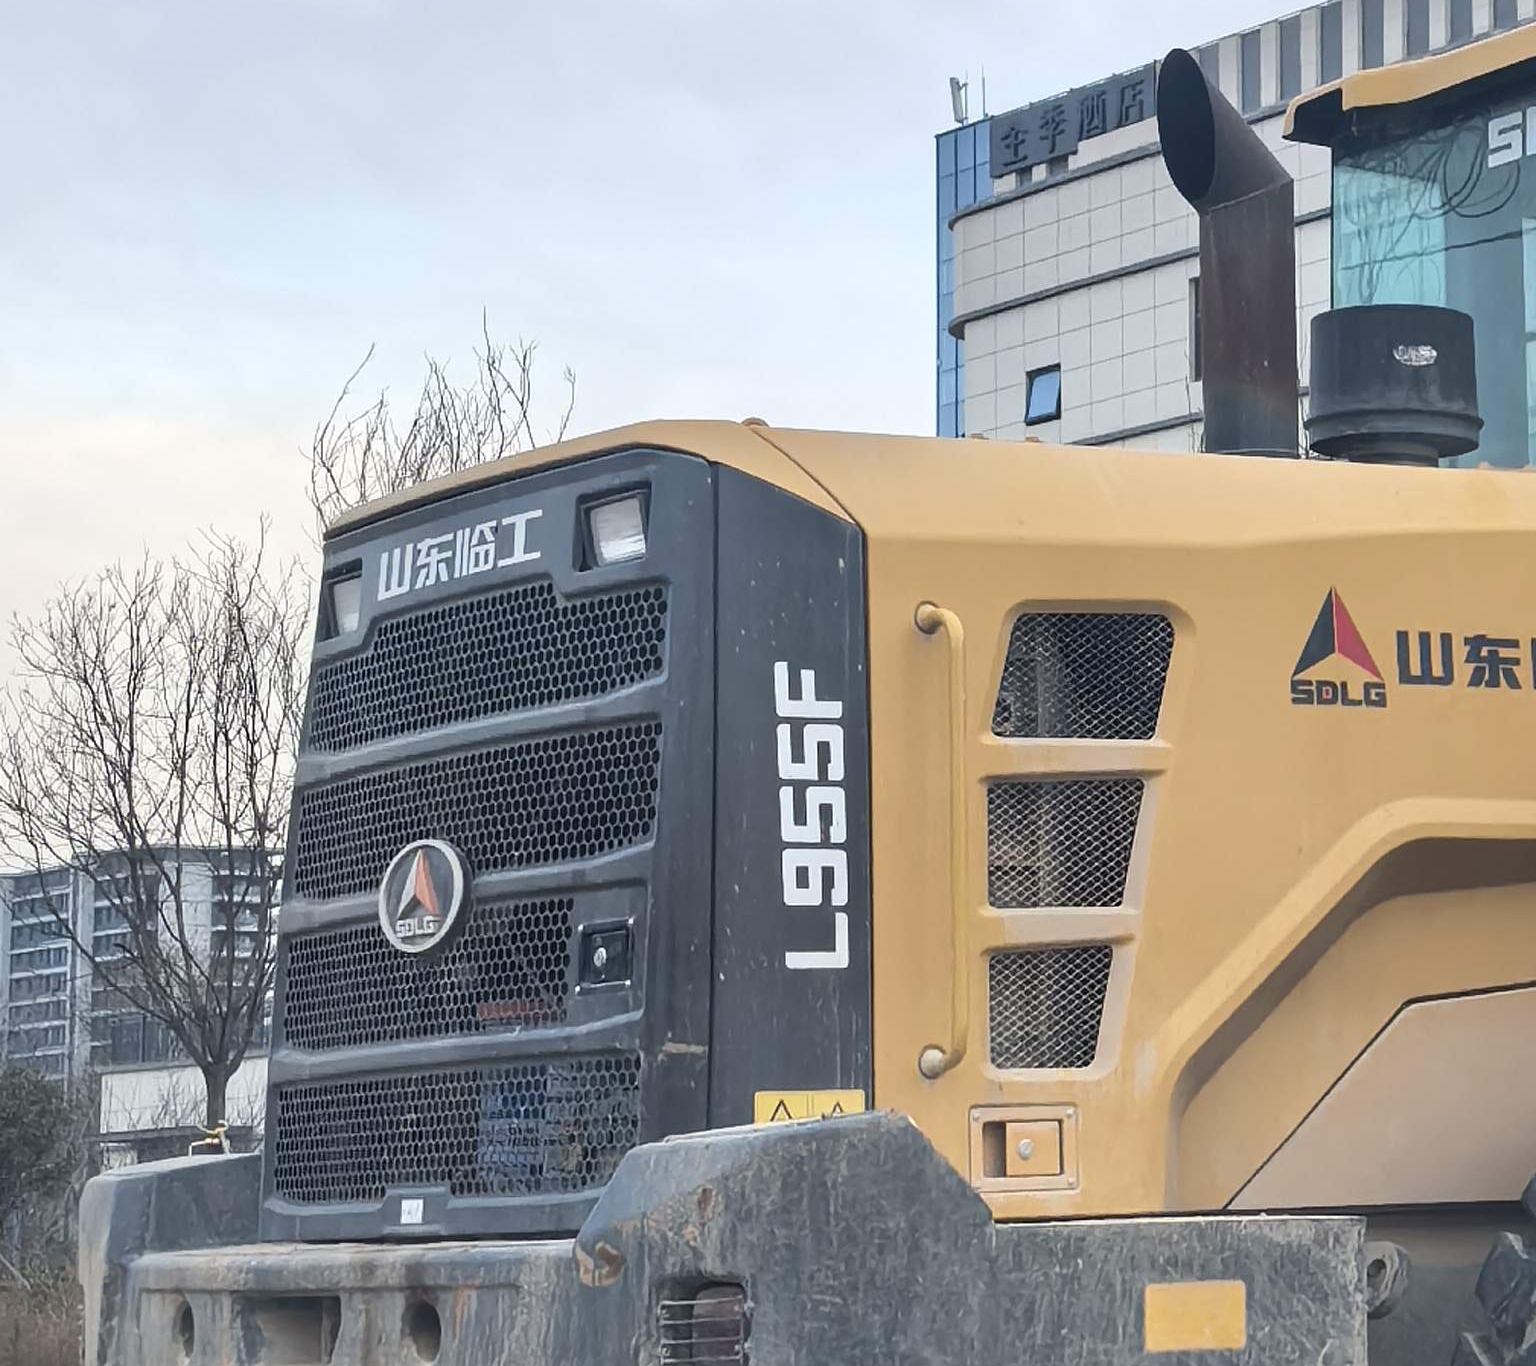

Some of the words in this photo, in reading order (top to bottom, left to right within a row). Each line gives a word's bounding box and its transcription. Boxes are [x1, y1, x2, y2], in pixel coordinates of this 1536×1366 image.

[1001, 79, 1144, 167] 全季酒店
[377, 509, 543, 602] 山东临工
[1290, 678, 1387, 708] SDLG
[773, 661, 850, 970] L955F
[395, 915, 441, 938] SDLG
